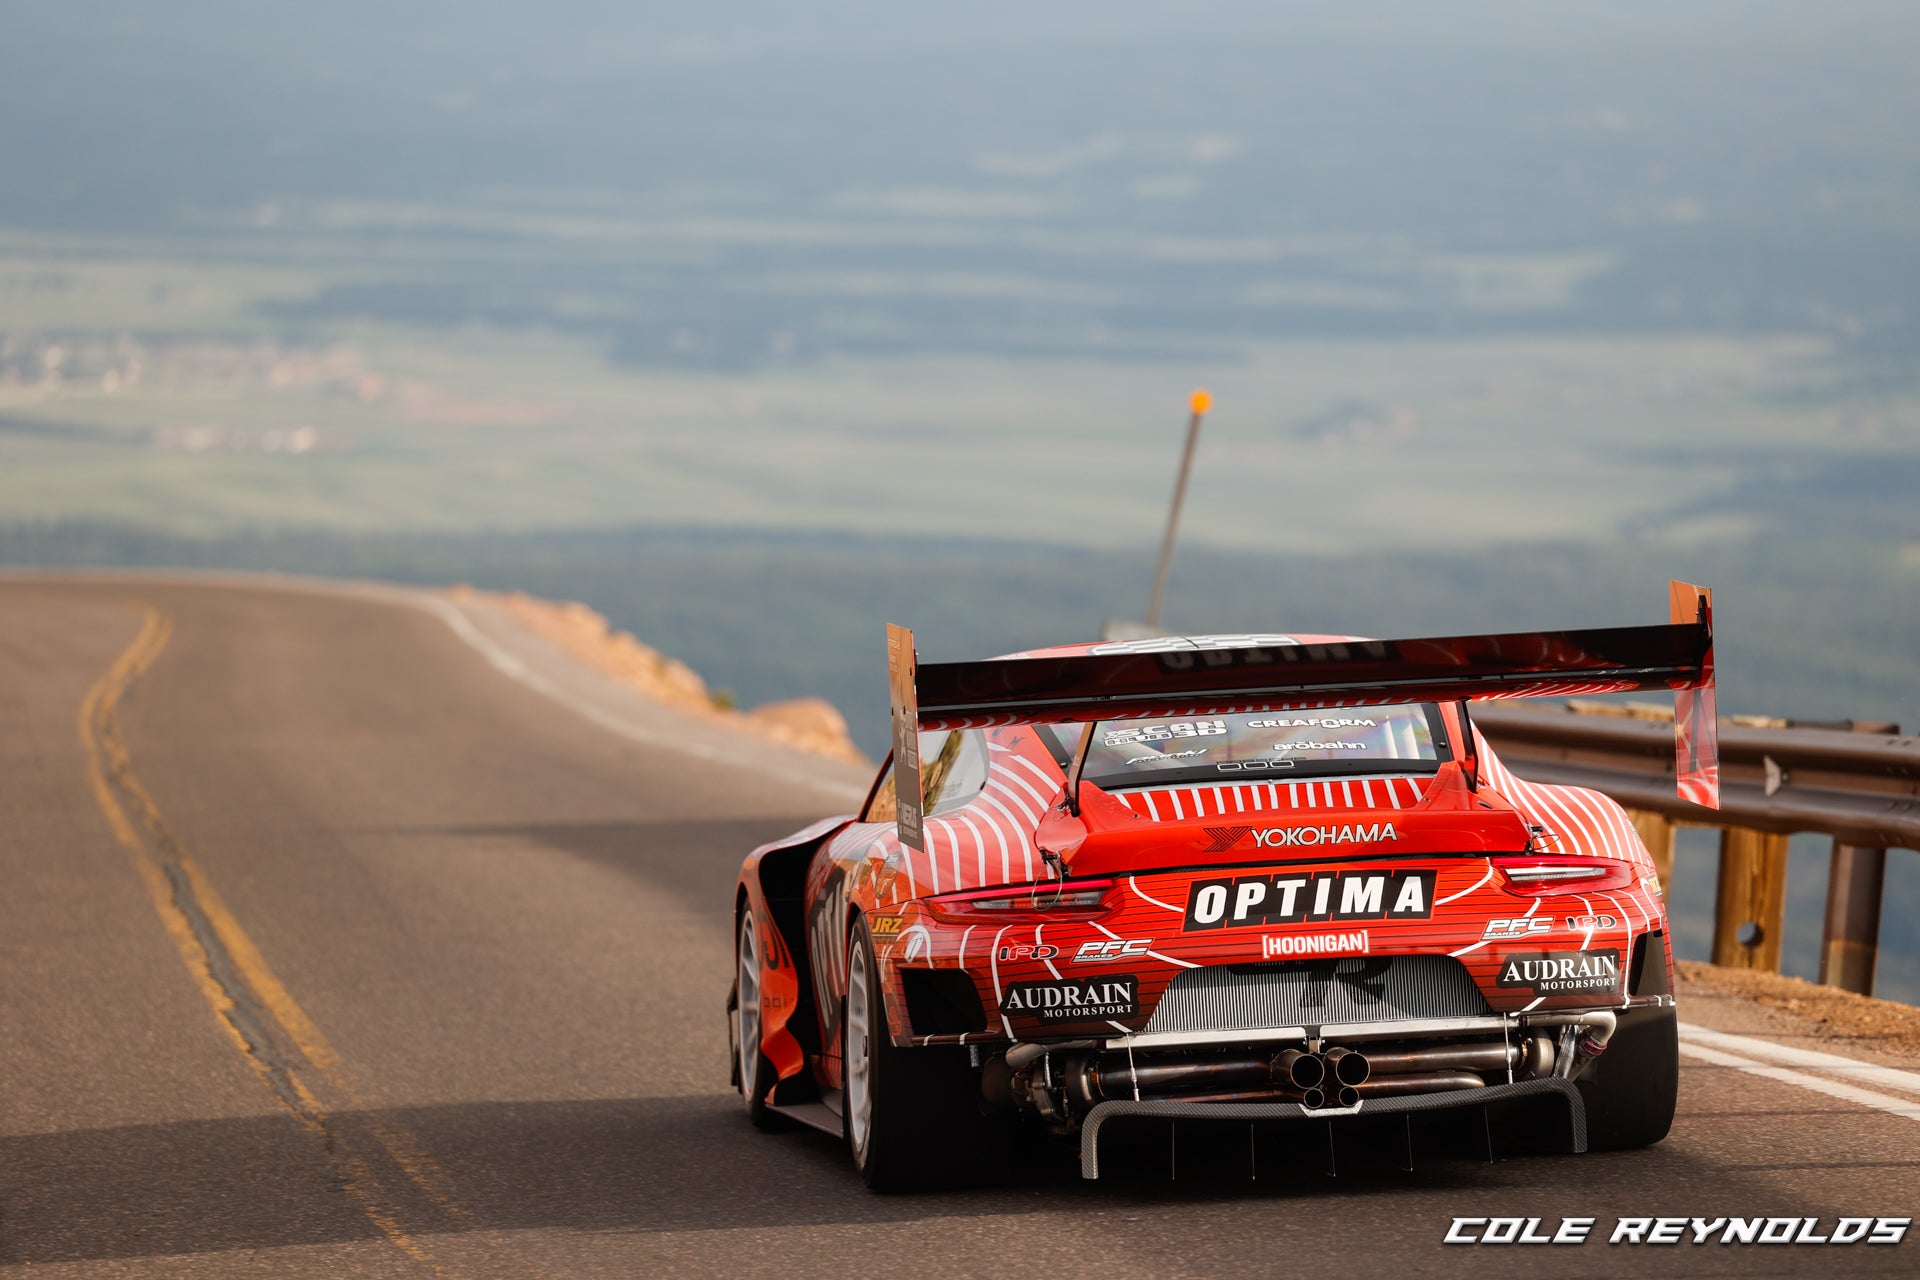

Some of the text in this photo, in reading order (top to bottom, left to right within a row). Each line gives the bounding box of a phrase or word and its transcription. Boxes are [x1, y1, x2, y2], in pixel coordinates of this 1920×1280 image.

[1247, 719, 1377, 729] CREAFORM
[1250, 822, 1398, 848] YOKOHAMA
[1194, 876, 1424, 924] OPTIMA
[872, 917, 903, 933] JRZ
[1484, 916, 1554, 934] PFC
[1077, 938, 1154, 957] PFC
[1503, 955, 1616, 982] AUDRAIN
[1540, 978, 1616, 990] MOTORSPORT
[1006, 982, 1132, 1009] AUDRAIN
[1044, 1004, 1133, 1018] MOTORSPORT
